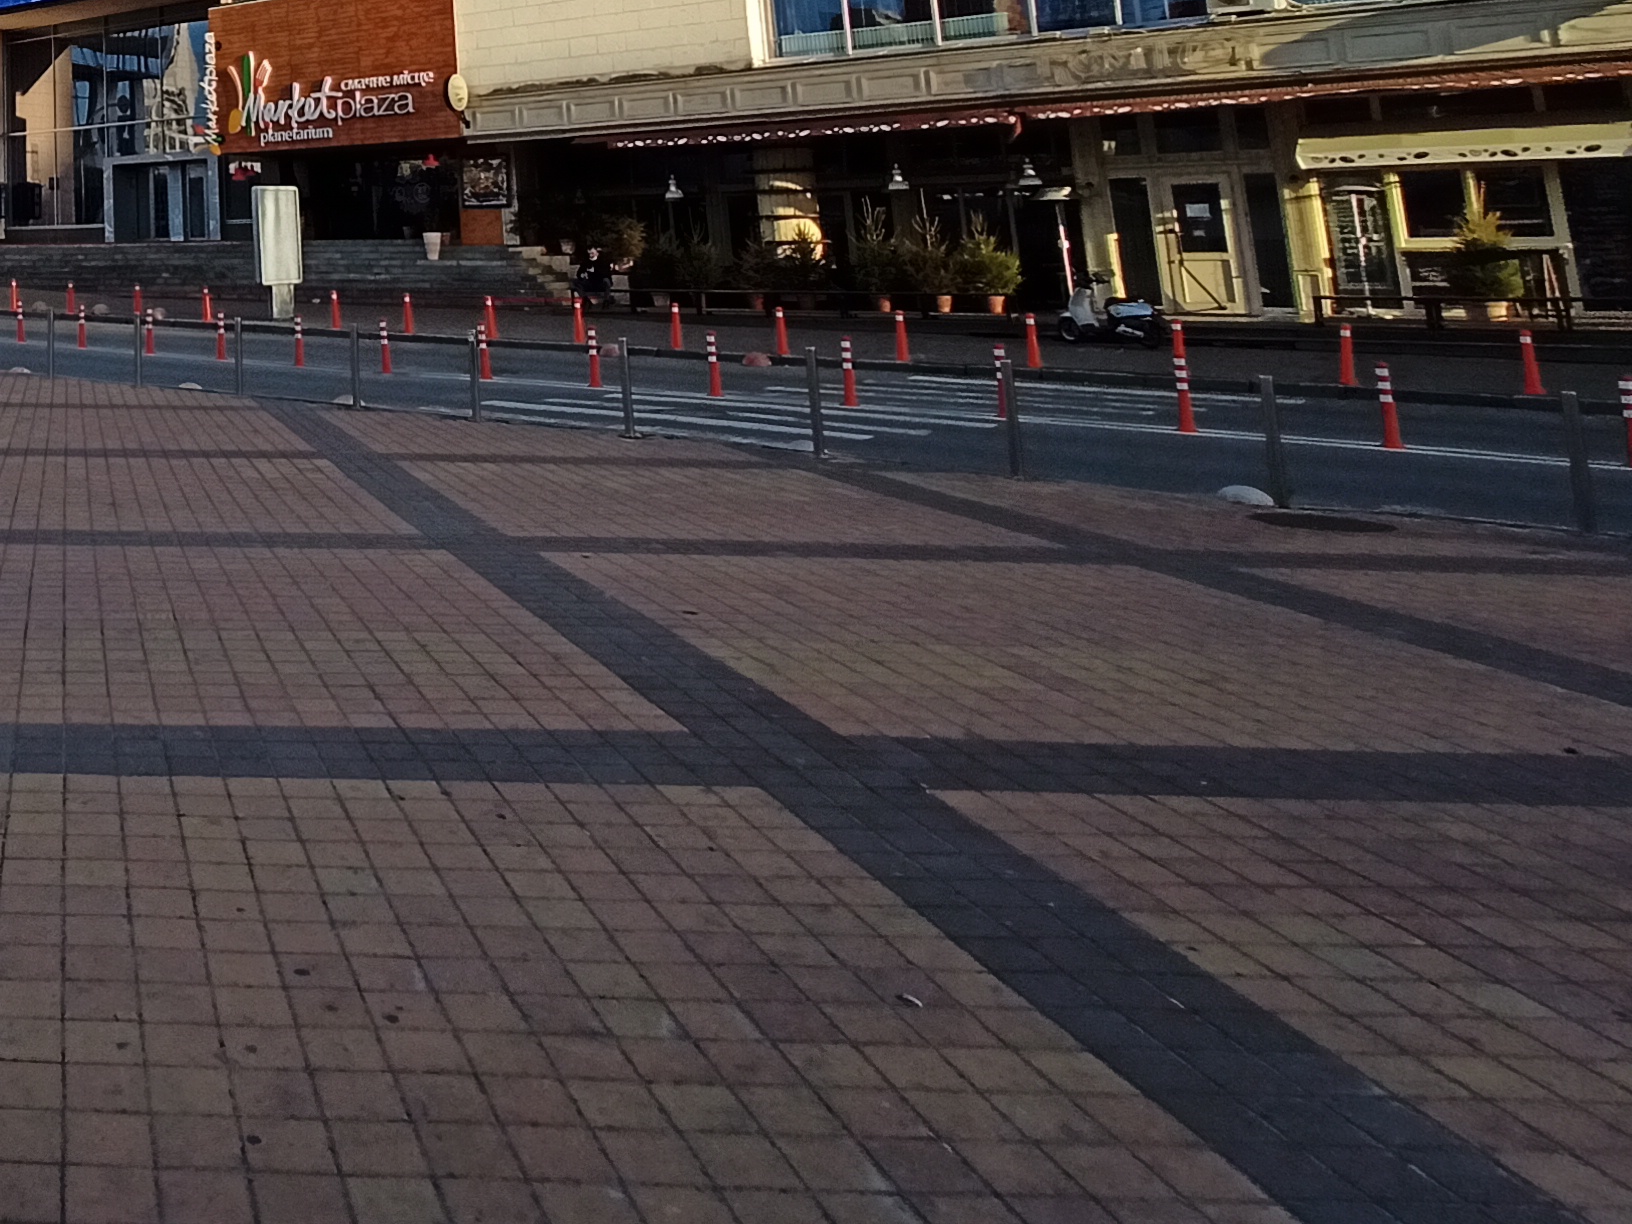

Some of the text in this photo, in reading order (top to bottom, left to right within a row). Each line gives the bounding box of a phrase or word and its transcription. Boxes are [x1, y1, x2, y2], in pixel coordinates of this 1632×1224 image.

[199, 31, 220, 146] Market plaza
[340, 70, 435, 91] смачне місце
[240, 76, 416, 130] Market plaza
[260, 125, 334, 147] planetarium
